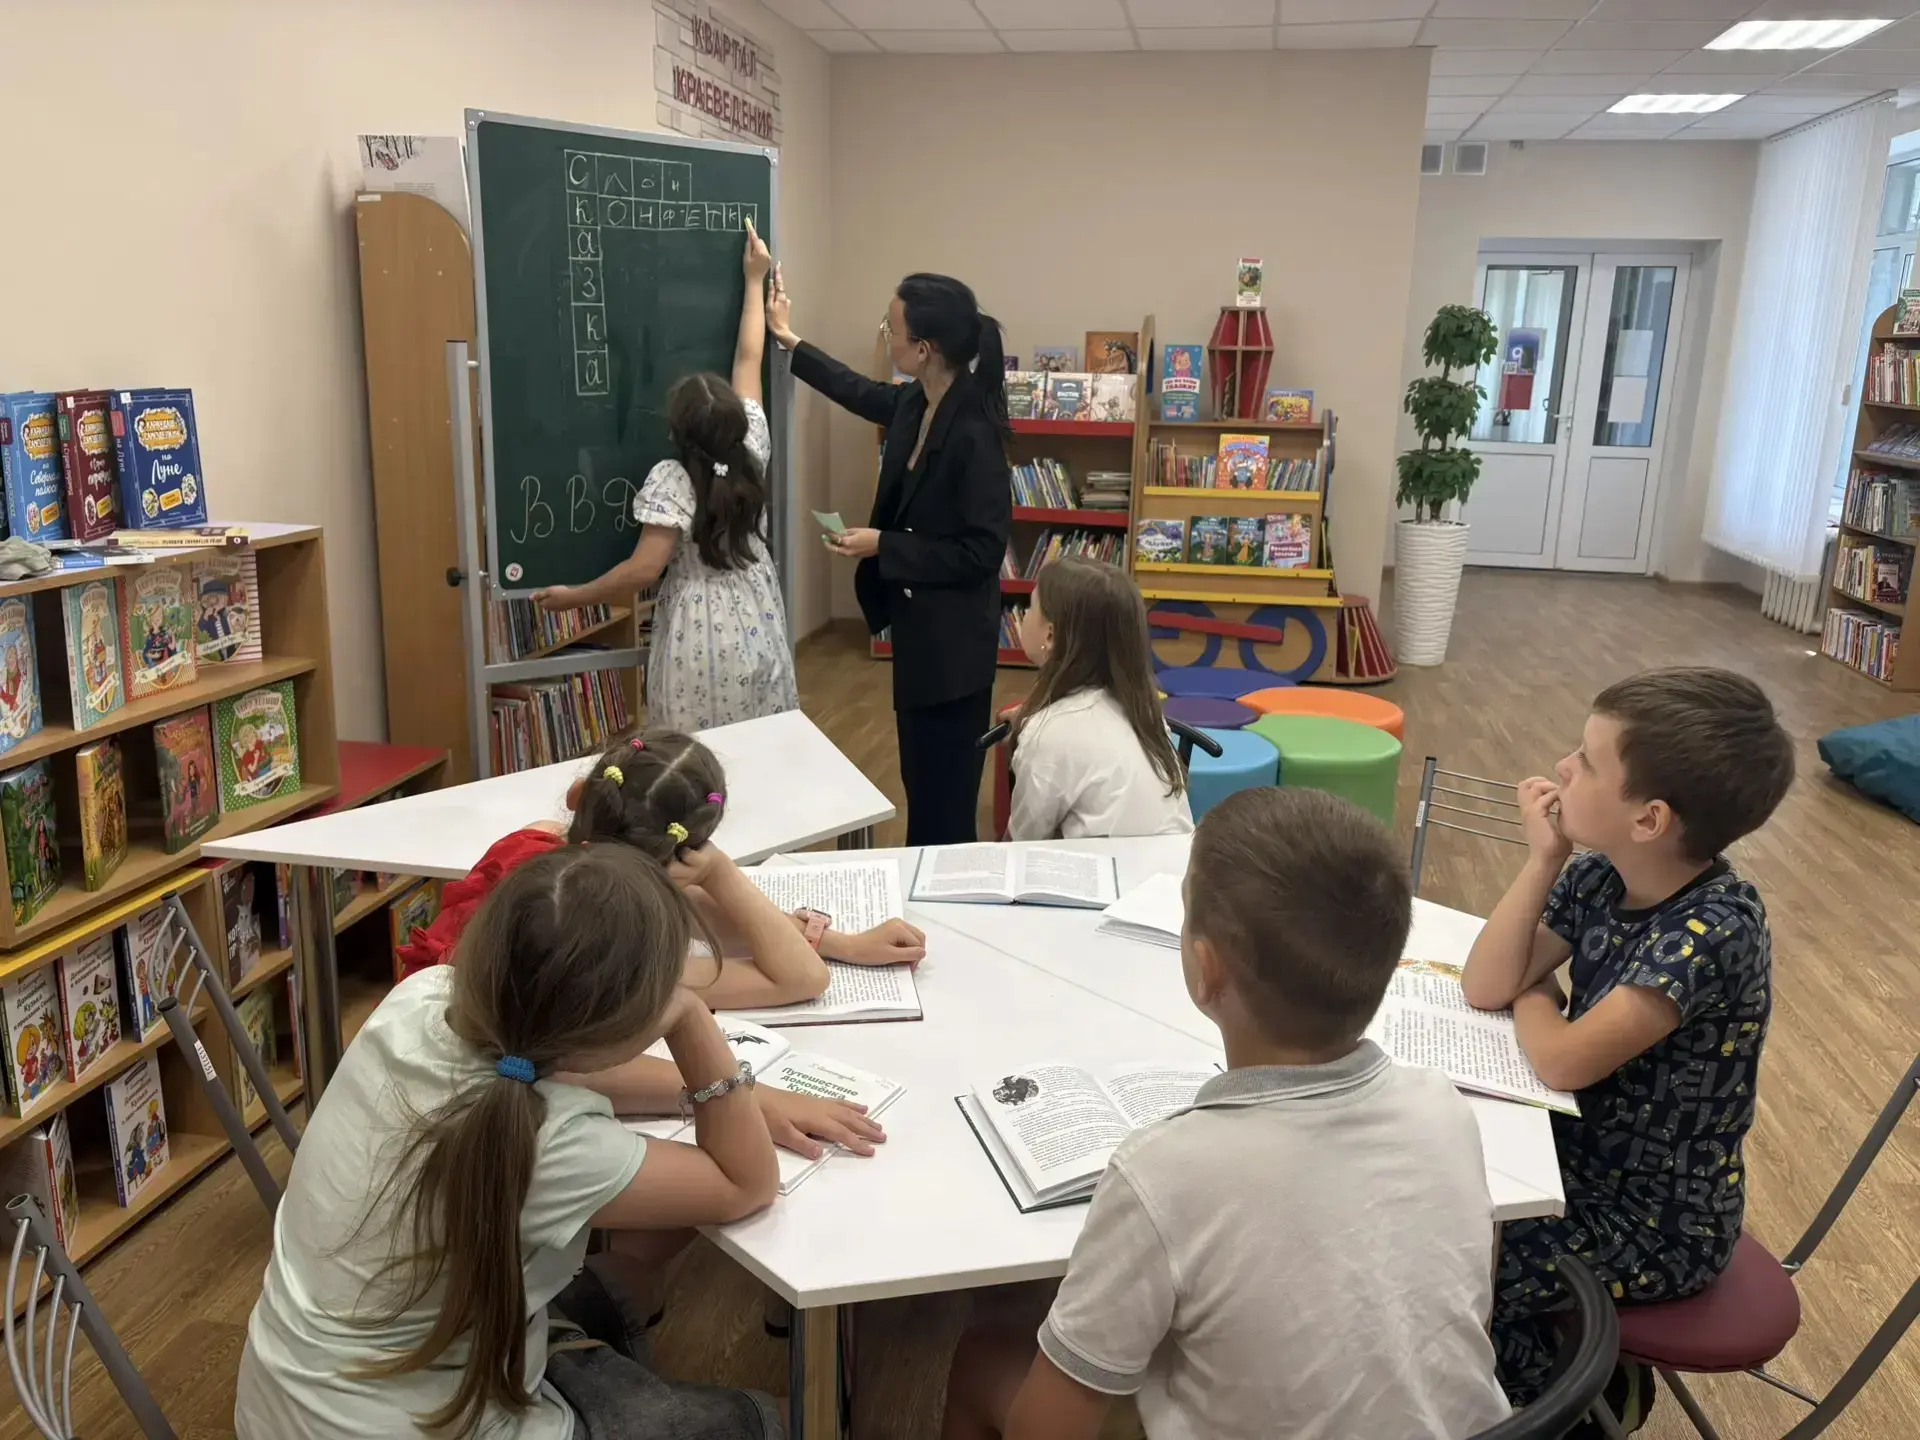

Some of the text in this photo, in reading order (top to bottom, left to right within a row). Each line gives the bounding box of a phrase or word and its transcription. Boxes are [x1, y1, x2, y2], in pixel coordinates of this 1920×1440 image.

[692, 14, 756, 79] КВАРТАЛ
[673, 64, 772, 141] КРАЕВЕДЕНИЯ
[162, 453, 173, 461] на
[152, 459, 183, 485] Луне
[780, 1075, 846, 1100] домовёнка
[781, 1067, 859, 1096] Путешествие
